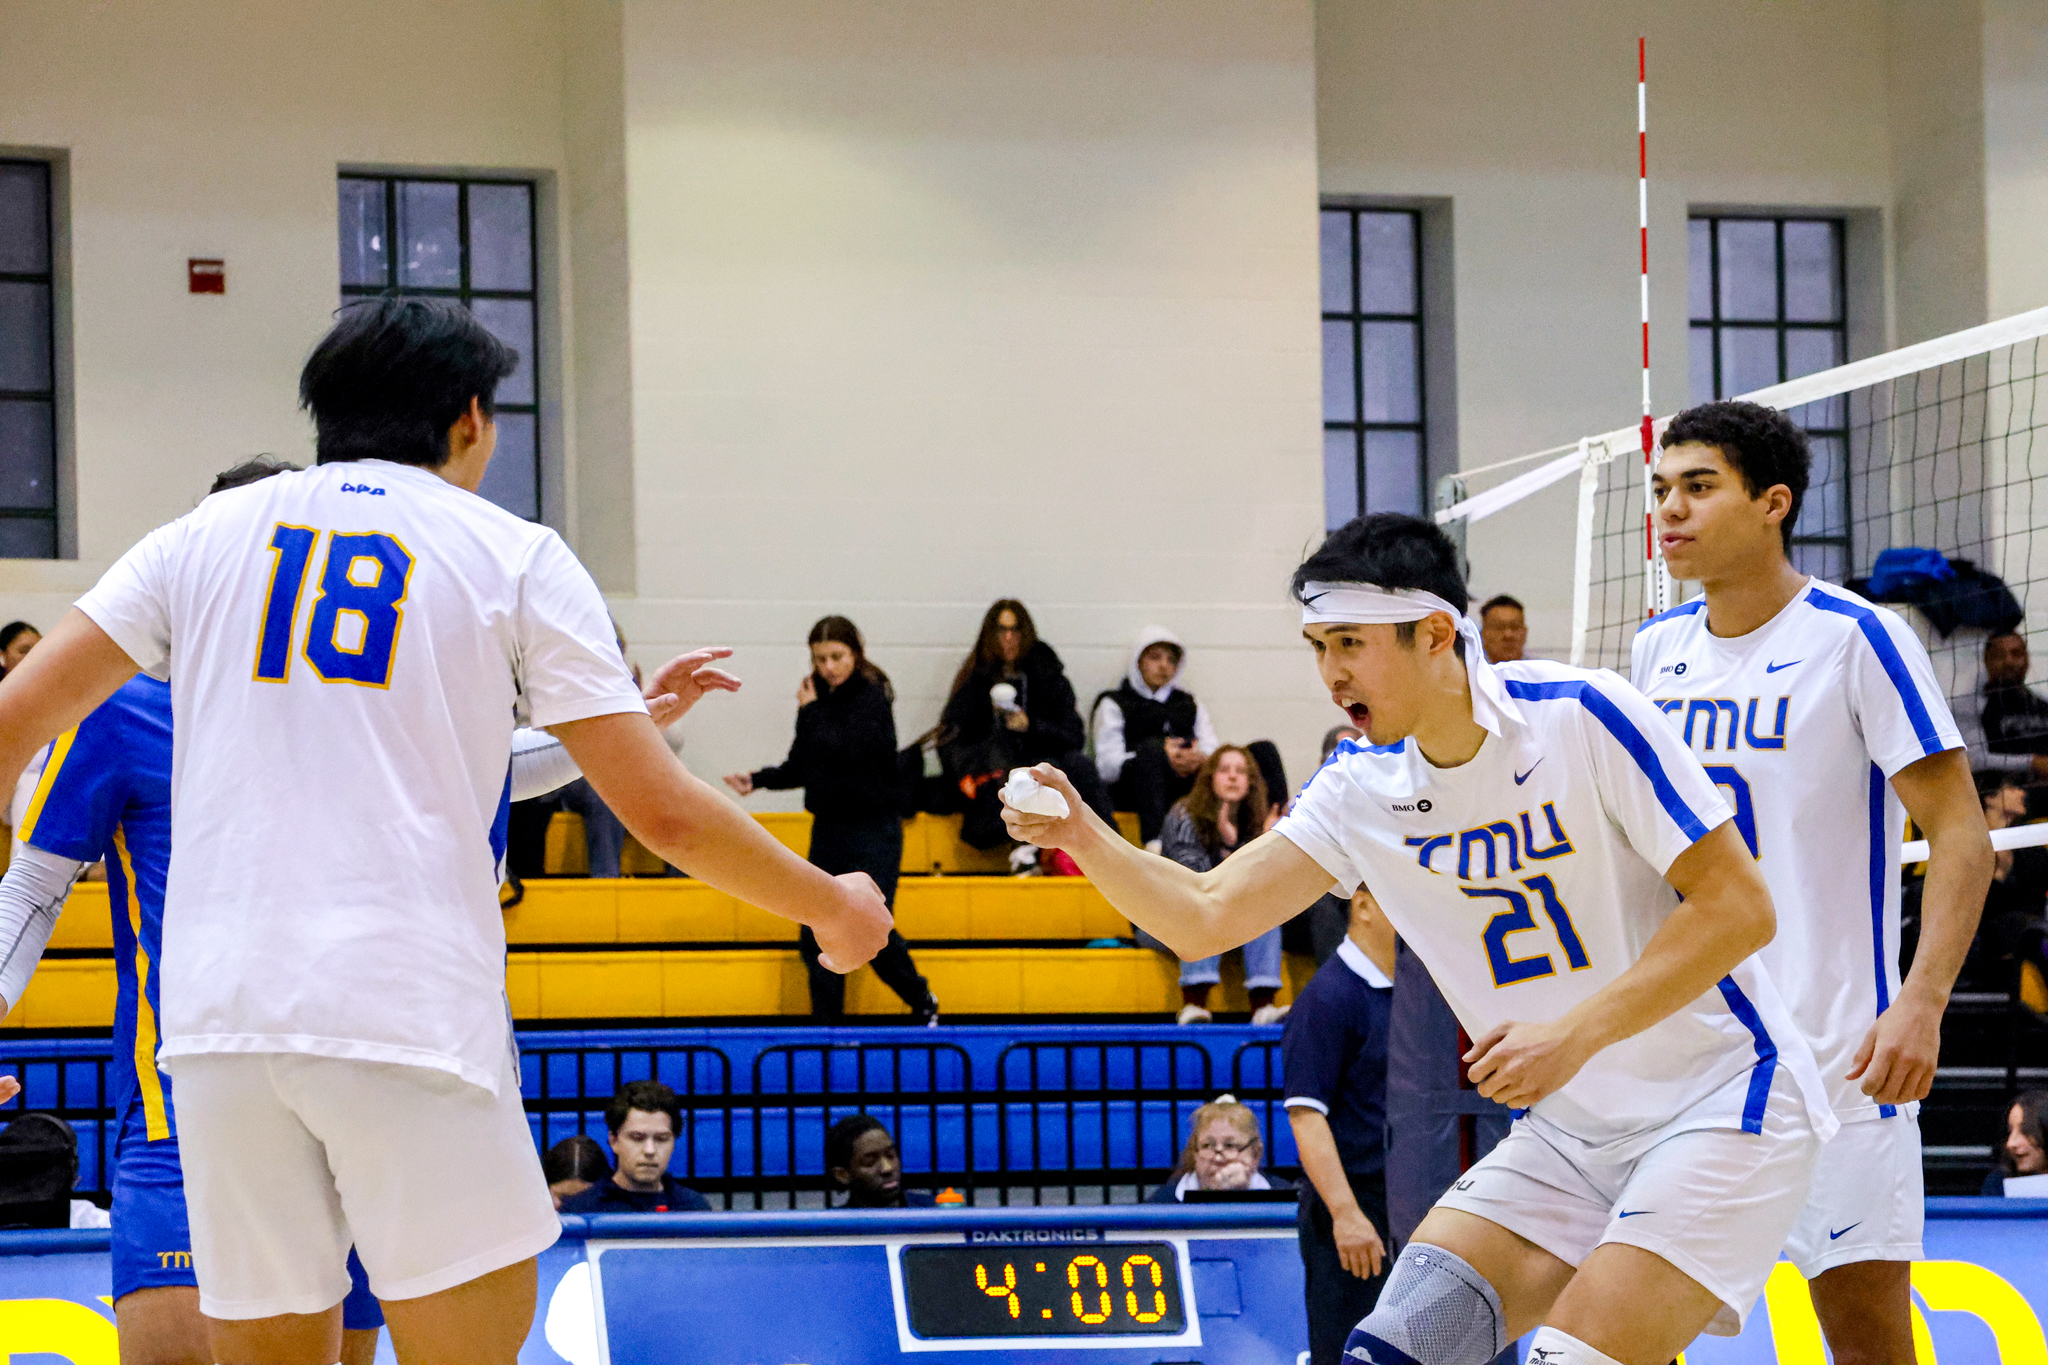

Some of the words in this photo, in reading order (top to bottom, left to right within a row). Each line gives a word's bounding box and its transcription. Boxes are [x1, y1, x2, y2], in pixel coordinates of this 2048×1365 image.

[252, 521, 416, 690] 18
[1391, 804, 1415, 812] BMO
[1404, 801, 1576, 880] TMU
[1458, 872, 1592, 989] 21
[972, 1229, 1099, 1243] DAKTRONICS
[975, 1254, 1167, 1324] 4:00
